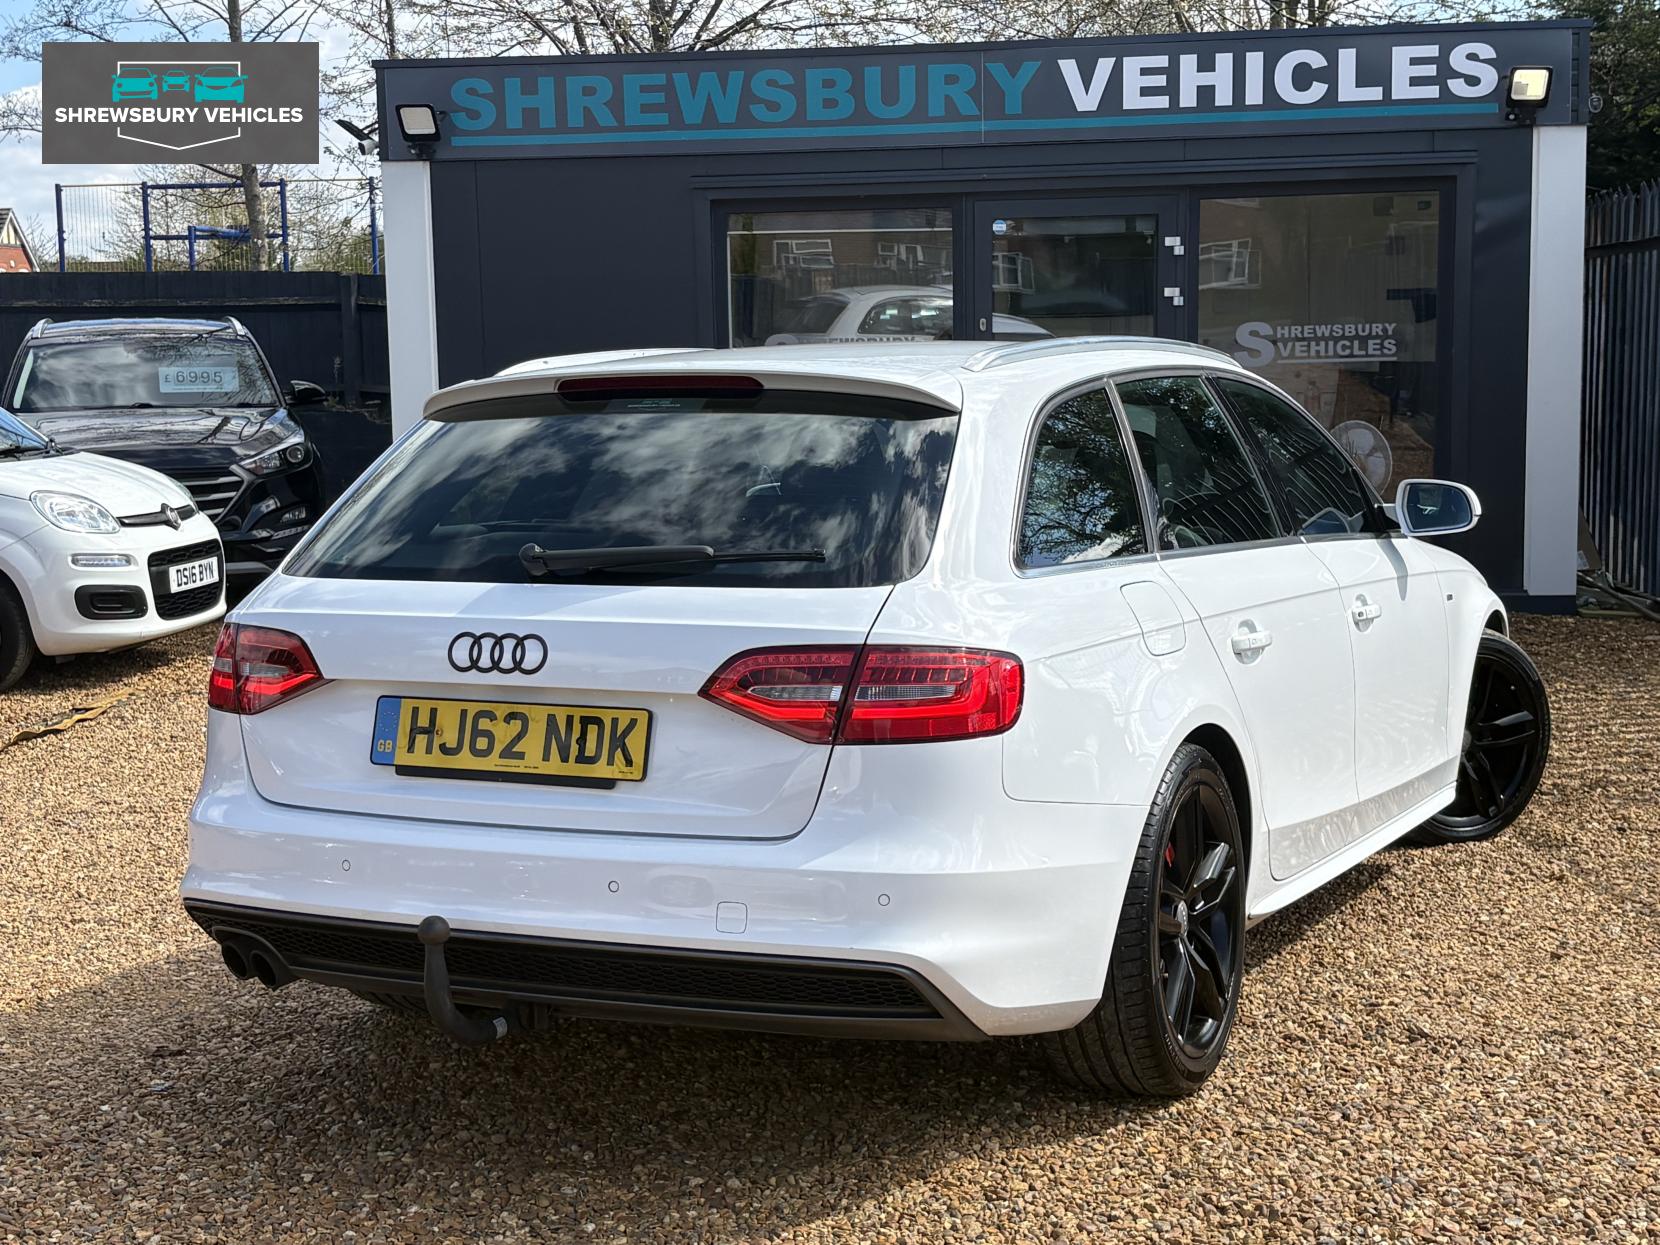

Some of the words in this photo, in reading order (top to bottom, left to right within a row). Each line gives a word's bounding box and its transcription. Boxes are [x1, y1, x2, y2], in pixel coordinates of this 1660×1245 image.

[450, 61, 1041, 131] SHREWSBURY
[1057, 42, 1499, 112] VEHICLES
[1276, 339, 1398, 357] VEHICLES
[176, 566, 197, 587] DS16
[198, 561, 214, 582] BYN
[377, 739, 392, 752] GB
[406, 706, 529, 761] HJ62
[541, 713, 638, 768] NDK
